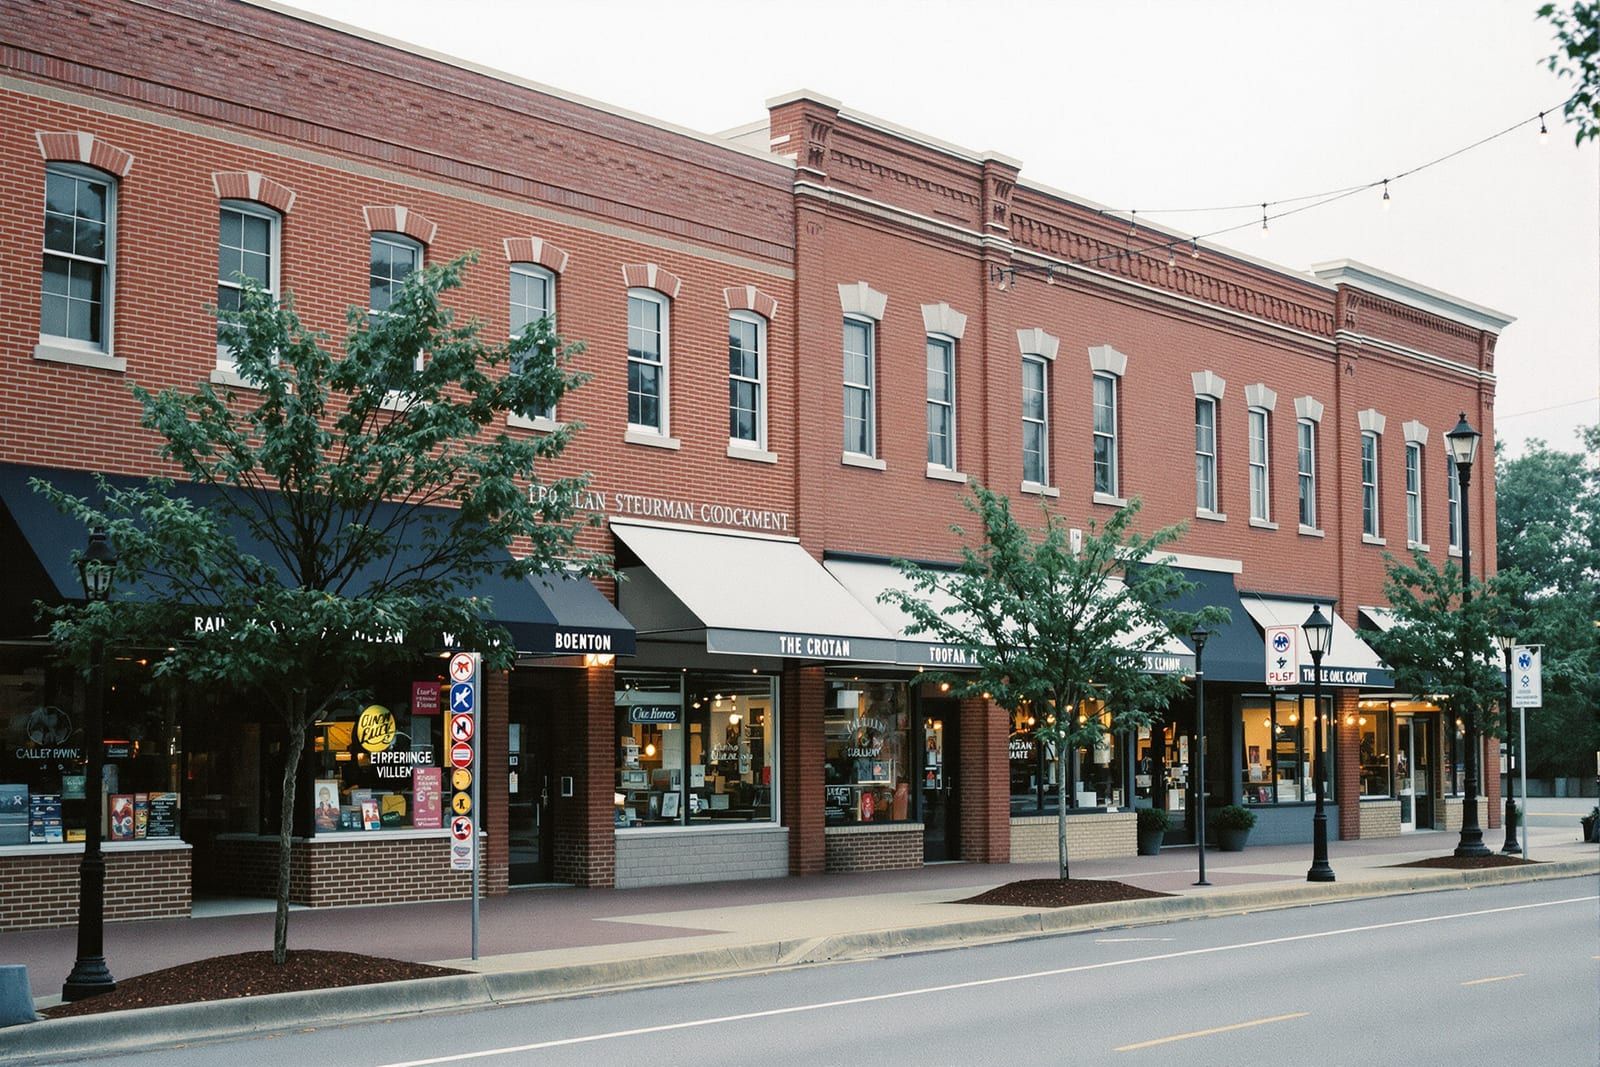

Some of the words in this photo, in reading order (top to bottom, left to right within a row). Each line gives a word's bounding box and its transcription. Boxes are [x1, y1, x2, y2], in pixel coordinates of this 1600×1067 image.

[615, 493, 694, 520] STEURMAN
[555, 632, 612, 650] BOENTON
[779, 636, 802, 654] THE
[806, 639, 850, 657] CROTAN
